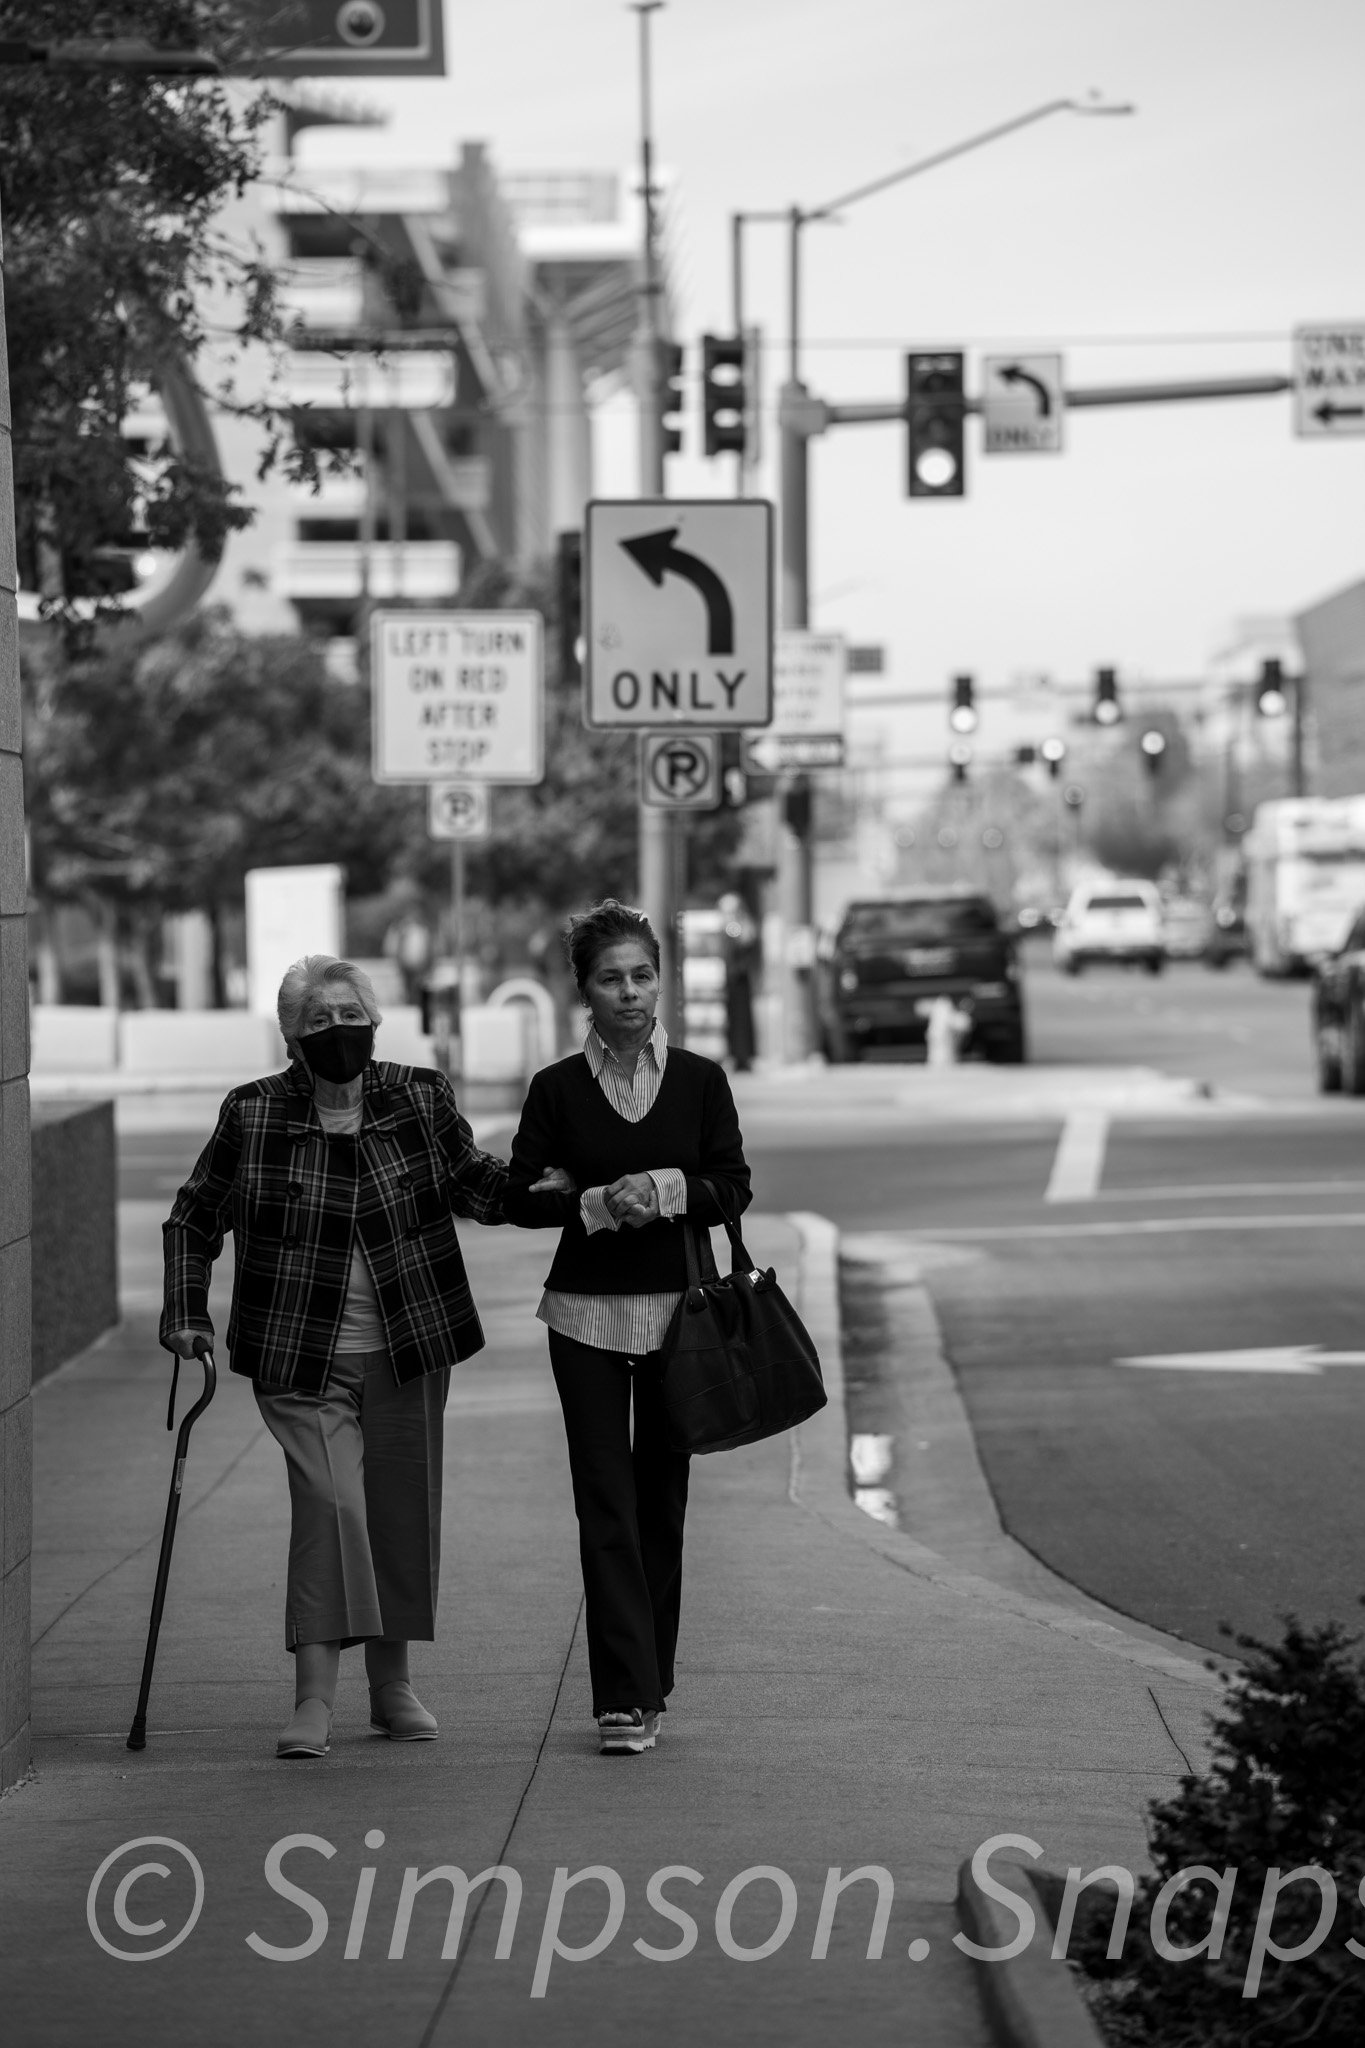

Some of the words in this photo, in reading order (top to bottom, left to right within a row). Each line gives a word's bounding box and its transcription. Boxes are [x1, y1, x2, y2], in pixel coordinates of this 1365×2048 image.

[388, 629, 449, 657] LEFT
[458, 629, 526, 657] TURN
[408, 663, 445, 694] ON
[456, 663, 508, 694] RED
[612, 670, 746, 711] ONLY
[418, 701, 498, 731] AFTER
[425, 736, 491, 767] STOP
